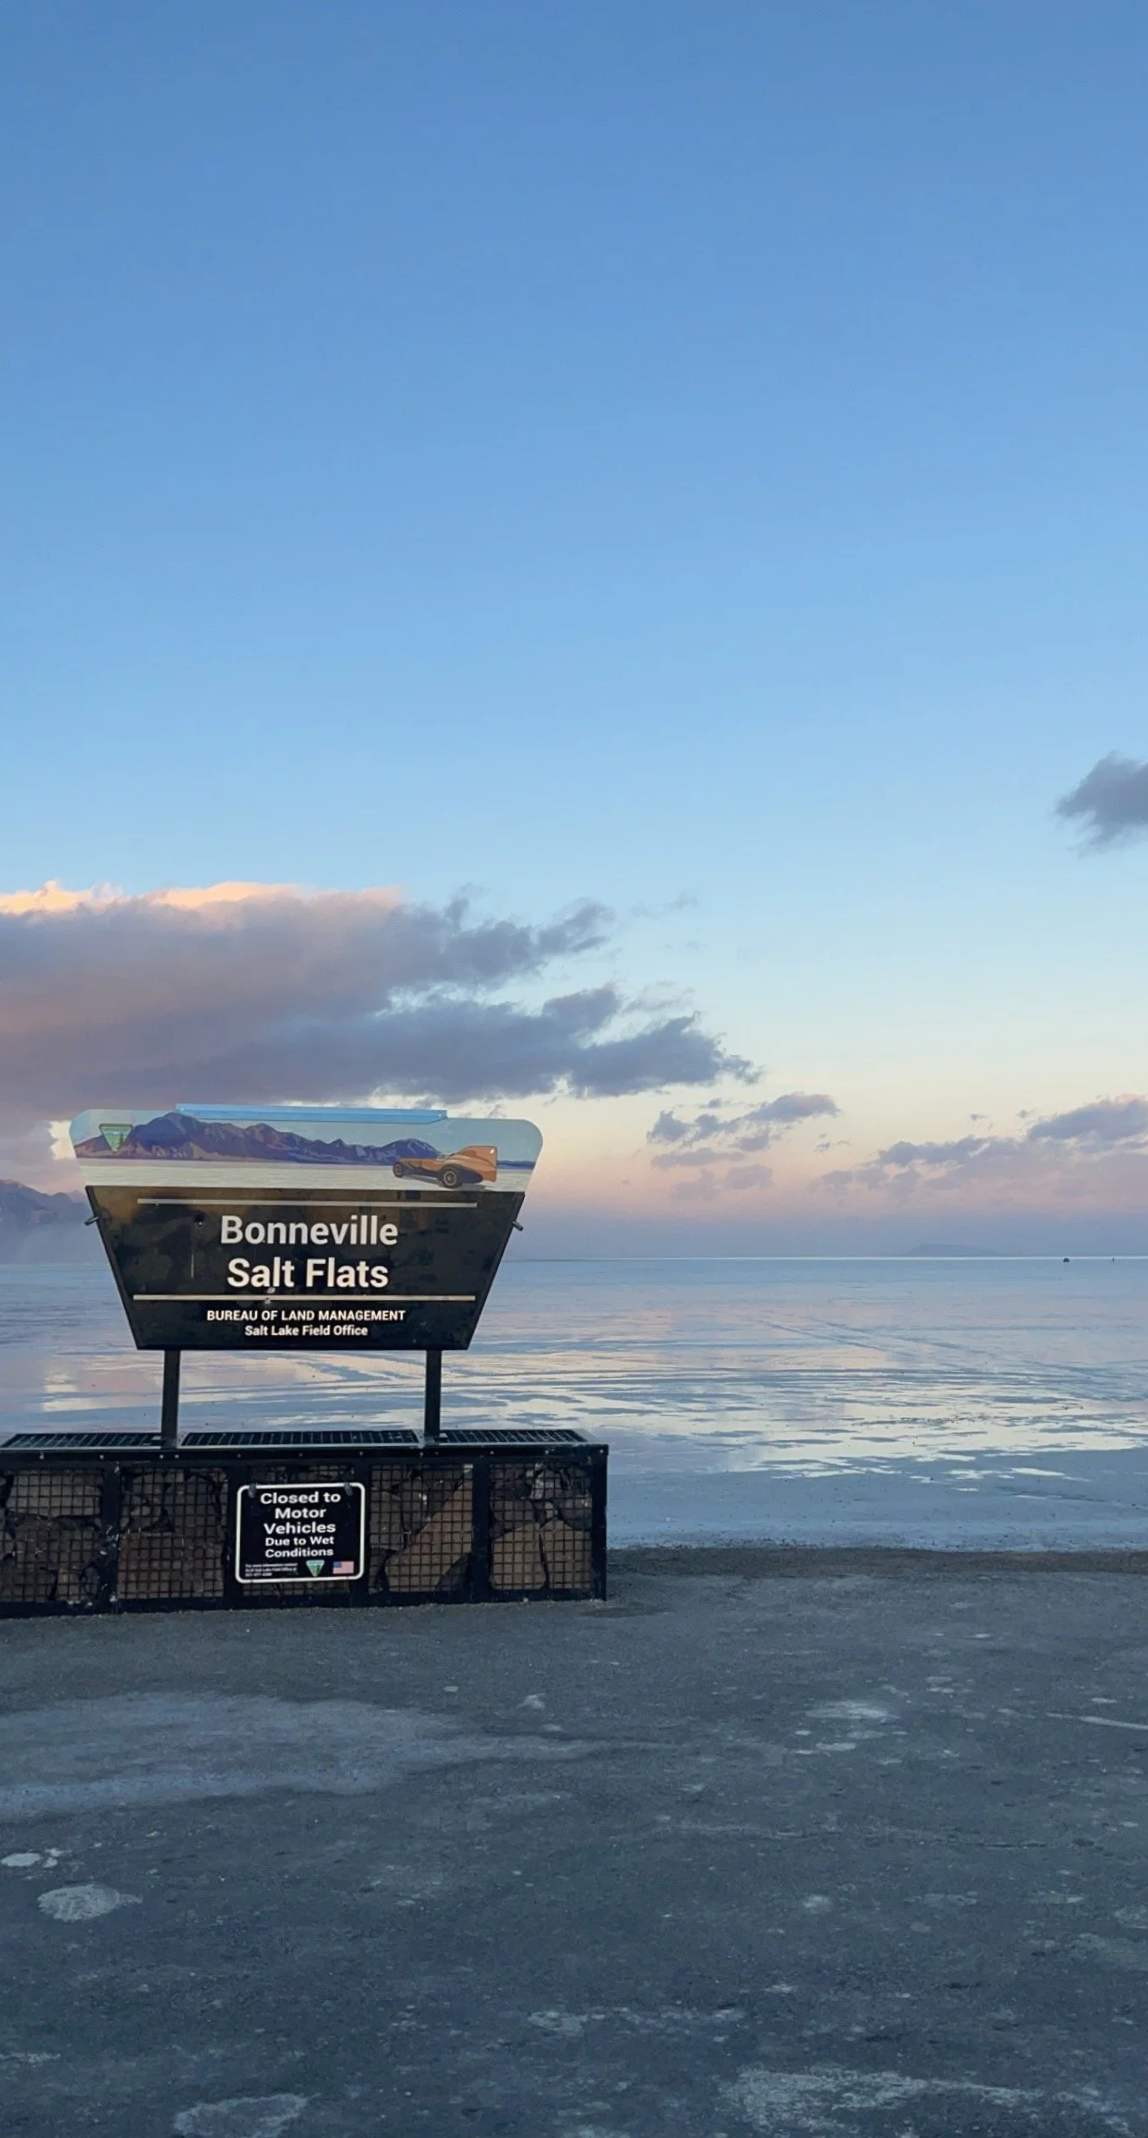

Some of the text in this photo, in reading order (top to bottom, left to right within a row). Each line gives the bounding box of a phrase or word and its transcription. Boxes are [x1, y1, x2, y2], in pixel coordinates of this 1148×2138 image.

[220, 1214, 398, 1246] Bonneville
[227, 1256, 389, 1288] Salt Flats
[206, 1310, 406, 1321] BUREAU OF LAND MANAGEMENT
[244, 1324, 369, 1336] Salt Lake Field Office
[260, 1491, 341, 1504] Closed to
[274, 1507, 327, 1519] Motor
[263, 1521, 336, 1534] Vehicles
[265, 1536, 335, 1546] Due to Wet
[265, 1547, 334, 1558] Conditions
